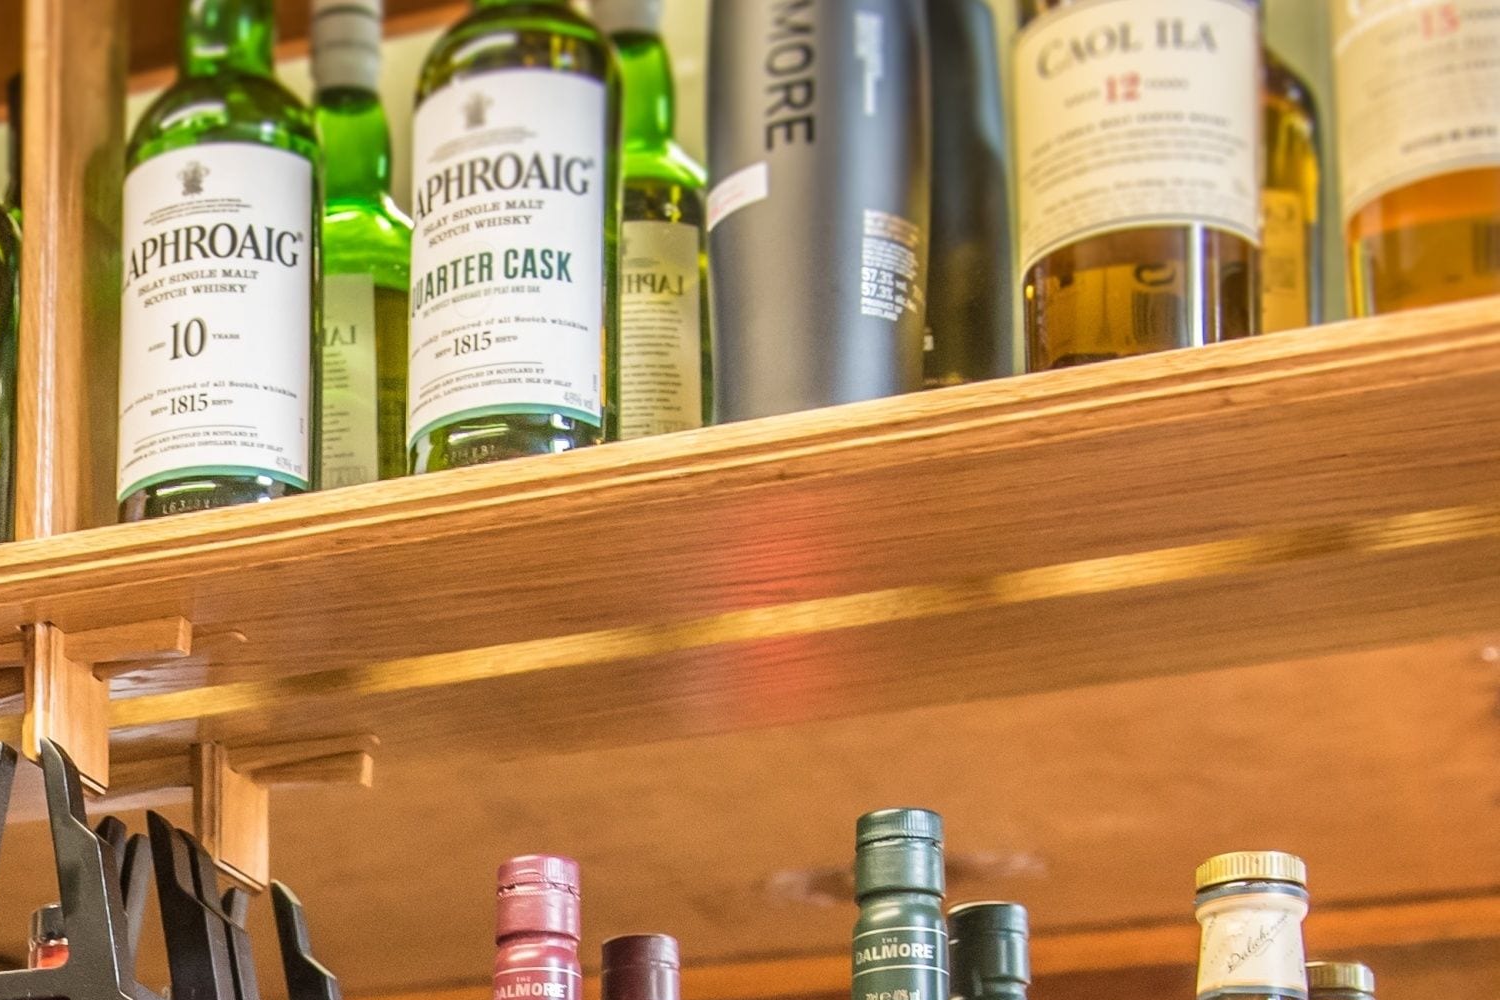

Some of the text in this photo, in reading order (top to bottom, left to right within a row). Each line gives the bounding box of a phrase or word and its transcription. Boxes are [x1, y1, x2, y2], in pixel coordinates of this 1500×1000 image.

[1036, 18, 1217, 80] CAOL ILA
[1105, 71, 1140, 104] 12
[414, 151, 589, 222] APHROAIG
[452, 202, 500, 221] SINGLE
[505, 200, 545, 211] MALT
[428, 215, 533, 248] SCOTCH WHISKY
[123, 222, 299, 292] APHROAIG
[503, 247, 573, 283] CASK
[169, 267, 218, 285] SINGLE
[221, 267, 260, 280] MALT
[143, 283, 248, 309] SCOTCH WHISKY
[498, 315, 511, 324] all
[171, 316, 208, 361] 10
[453, 330, 493, 357] 1815
[213, 380, 226, 388] all
[169, 392, 209, 416] 1815
[856, 942, 935, 966] DALMORE
